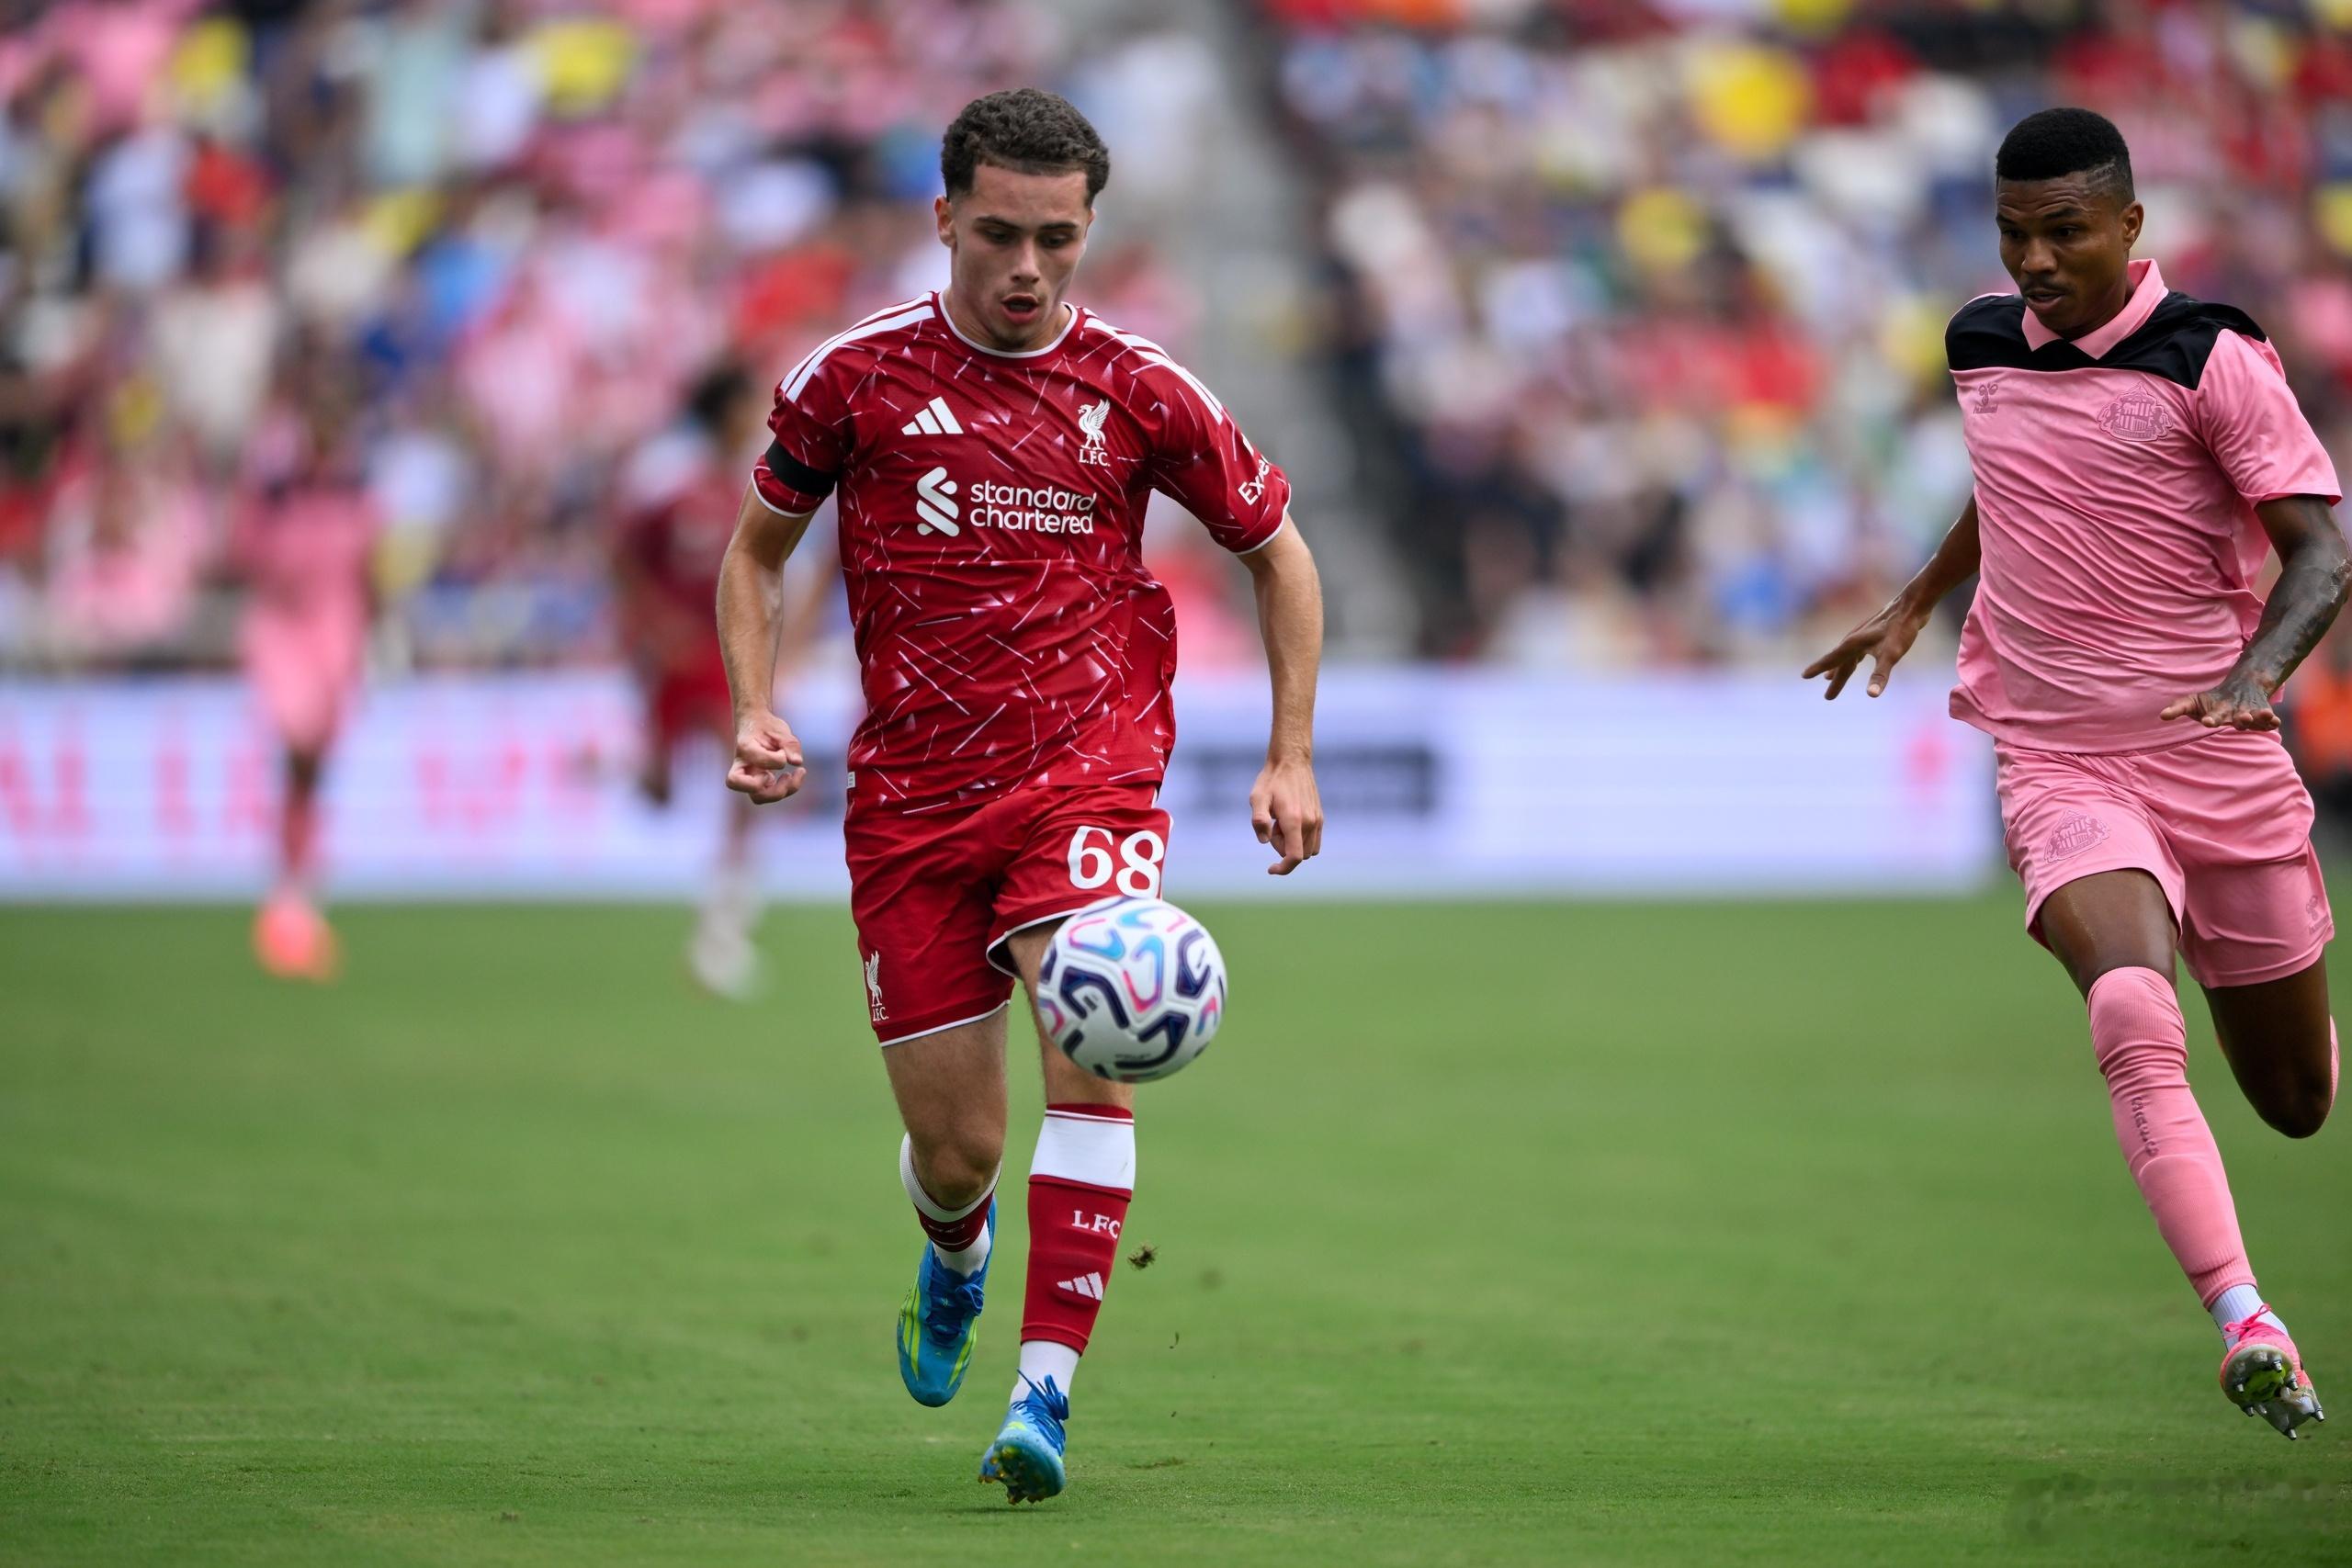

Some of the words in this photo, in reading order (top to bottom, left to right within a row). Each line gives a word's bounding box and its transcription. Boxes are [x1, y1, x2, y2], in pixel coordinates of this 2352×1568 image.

[970, 480, 1097, 512] standard
[970, 504, 1094, 535] chartered
[1068, 825, 1165, 898] 68
